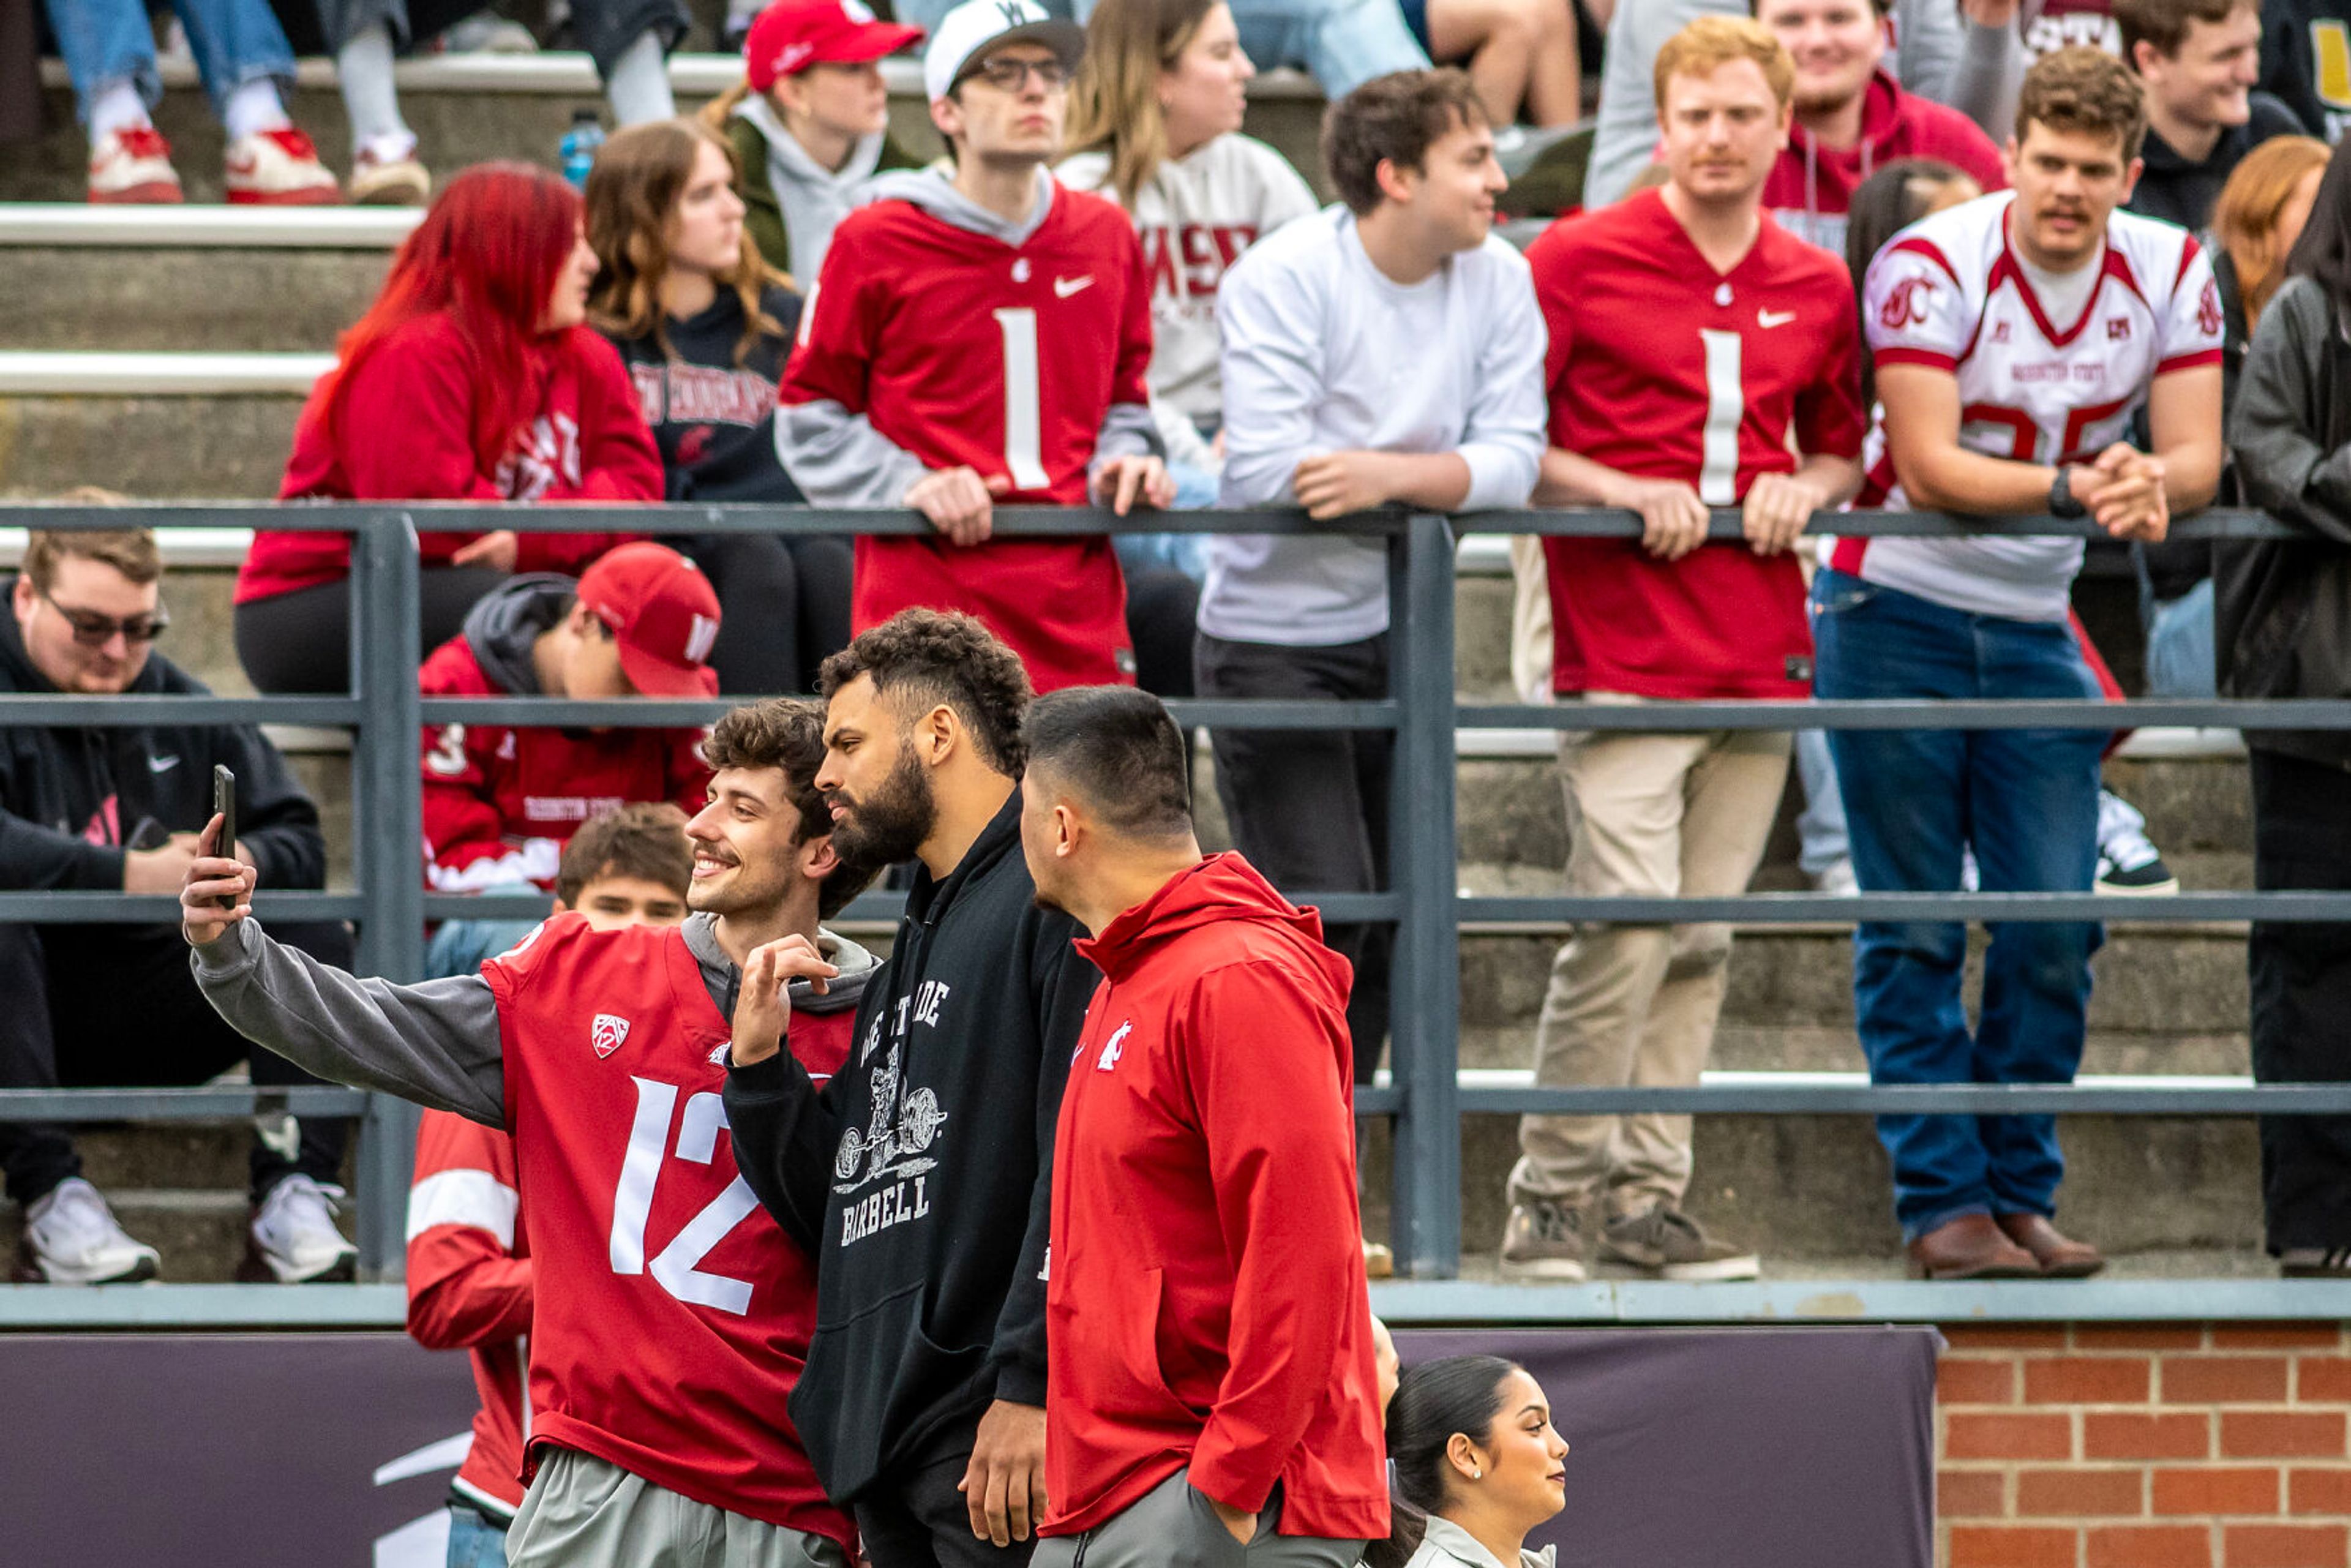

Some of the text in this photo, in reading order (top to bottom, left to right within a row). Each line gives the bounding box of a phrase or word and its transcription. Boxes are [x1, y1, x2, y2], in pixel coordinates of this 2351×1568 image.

[991, 307, 1051, 490] 1
[1698, 328, 1744, 506] 1
[592, 1014, 630, 1045] PAC
[596, 1032, 616, 1050] 12
[610, 1075, 760, 1316] 12
